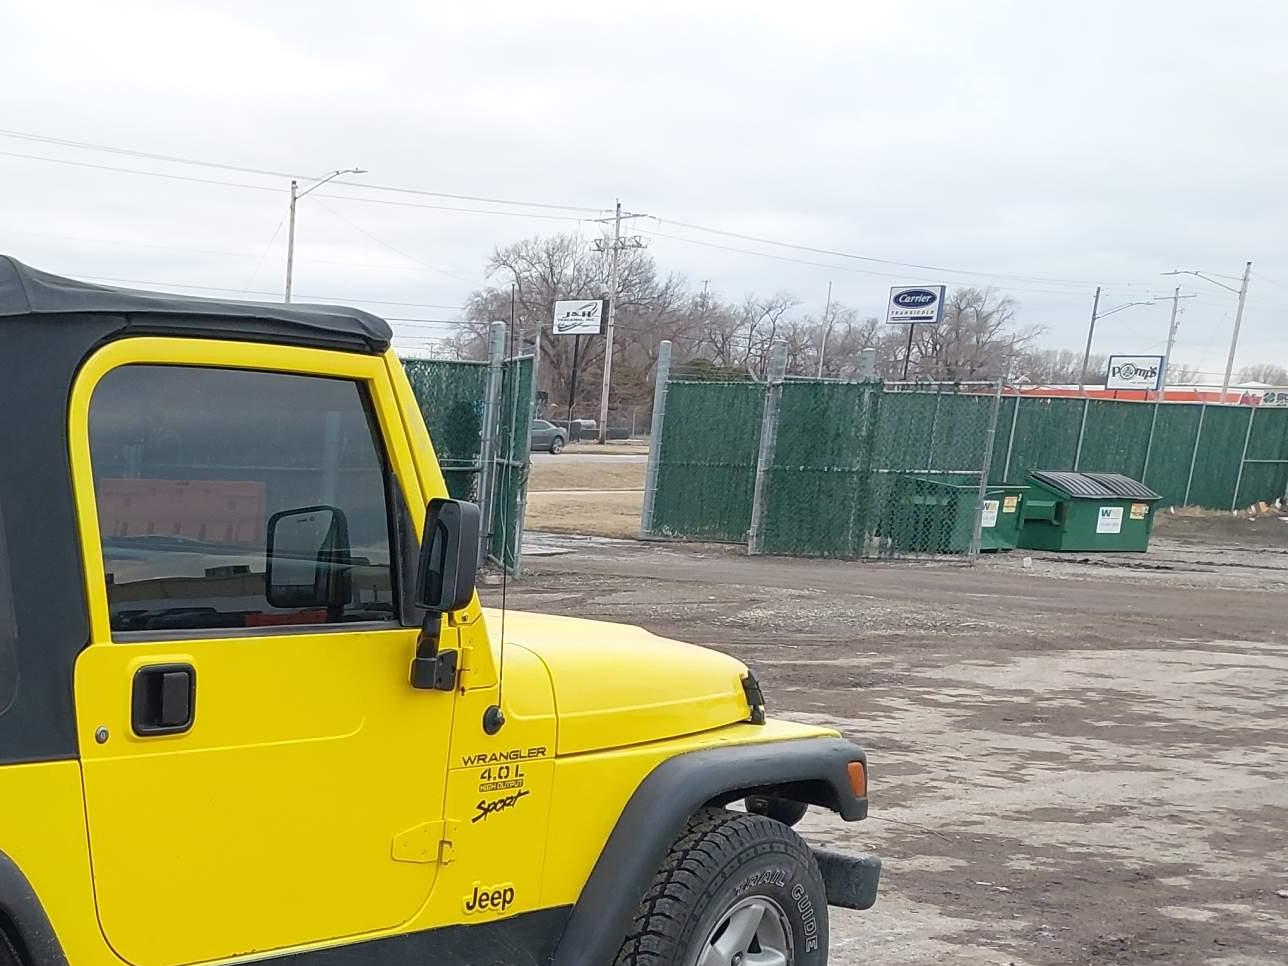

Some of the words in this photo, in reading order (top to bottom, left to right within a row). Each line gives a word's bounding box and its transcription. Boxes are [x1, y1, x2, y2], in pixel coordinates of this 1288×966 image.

[899, 293, 932, 303] Carrier
[461, 746, 547, 766] WRANGLER
[465, 886, 515, 911] Jeep
[735, 869, 787, 897] TRAIL
[791, 883, 819, 953] GUIDE
